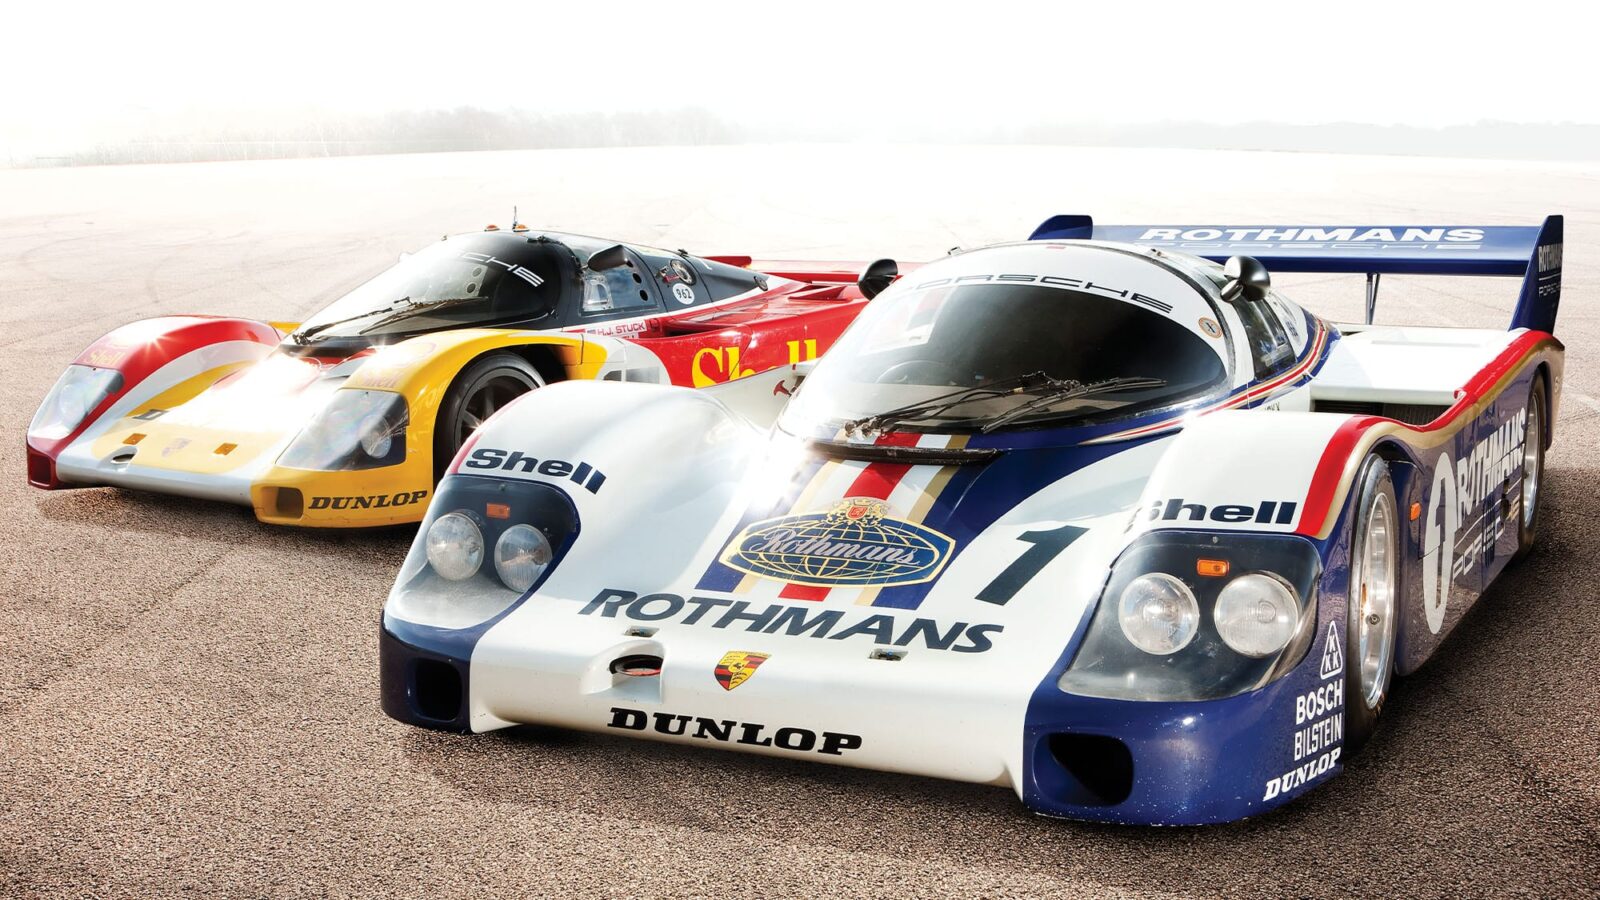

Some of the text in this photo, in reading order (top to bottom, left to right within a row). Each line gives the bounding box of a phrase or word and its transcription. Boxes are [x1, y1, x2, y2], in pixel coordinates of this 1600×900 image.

[1139, 228, 1484, 242] ROTHMANS
[676, 289, 692, 299] 962
[912, 274, 1173, 314] ORSCHE
[615, 322, 645, 334] STUCK
[465, 448, 607, 495] Shell
[1456, 407, 1526, 529] ROTHMANS
[308, 490, 428, 509] DUNLOP
[750, 528, 920, 565] Rothmans
[974, 525, 1091, 606] 1
[578, 588, 1004, 653] ROTHMANS
[1329, 634, 1336, 653] K
[1295, 678, 1343, 726] BOSCH
[607, 707, 863, 756] DUNLOP
[1294, 712, 1342, 762] BILSTEIN
[1262, 746, 1342, 802] DUNLOP
